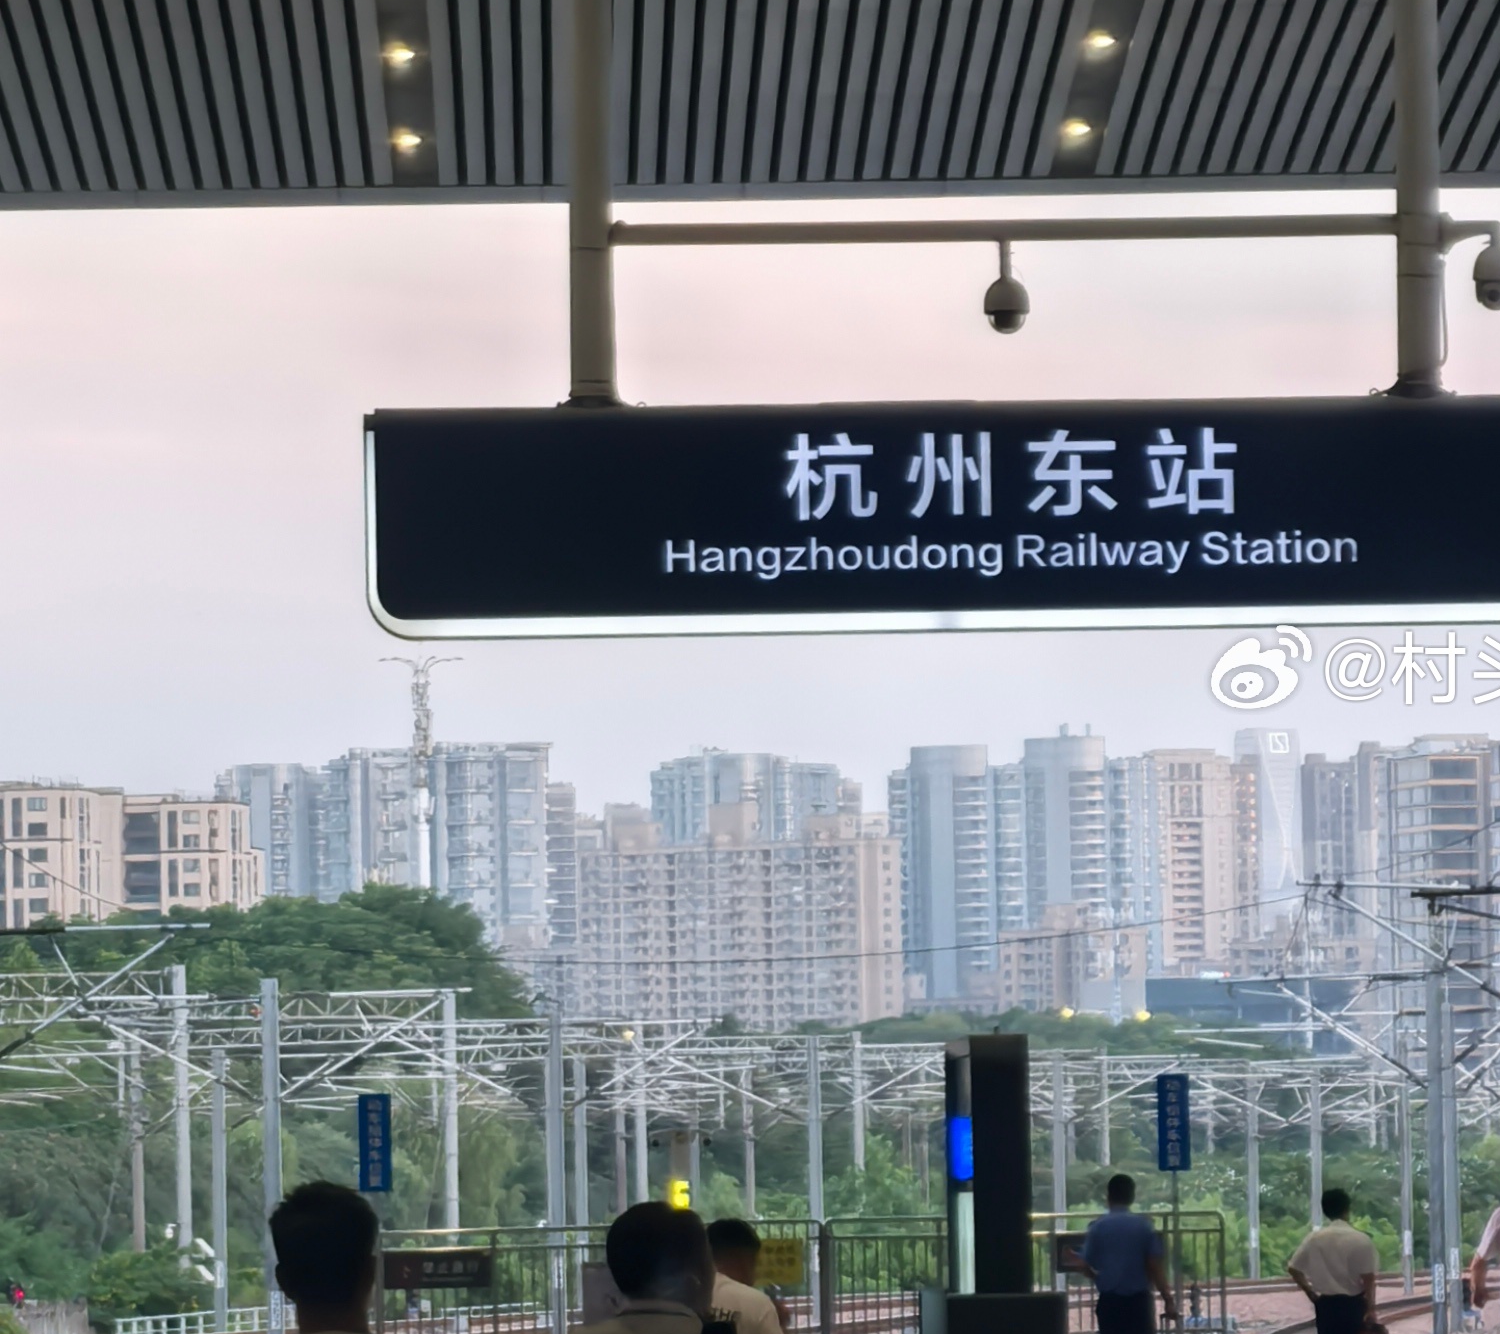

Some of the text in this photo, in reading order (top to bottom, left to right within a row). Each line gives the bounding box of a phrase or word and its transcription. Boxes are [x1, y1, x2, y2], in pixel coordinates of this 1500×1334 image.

[787, 428, 1238, 521] 杭州东站
[665, 529, 1359, 579] Hangzhoudong Railway Station
